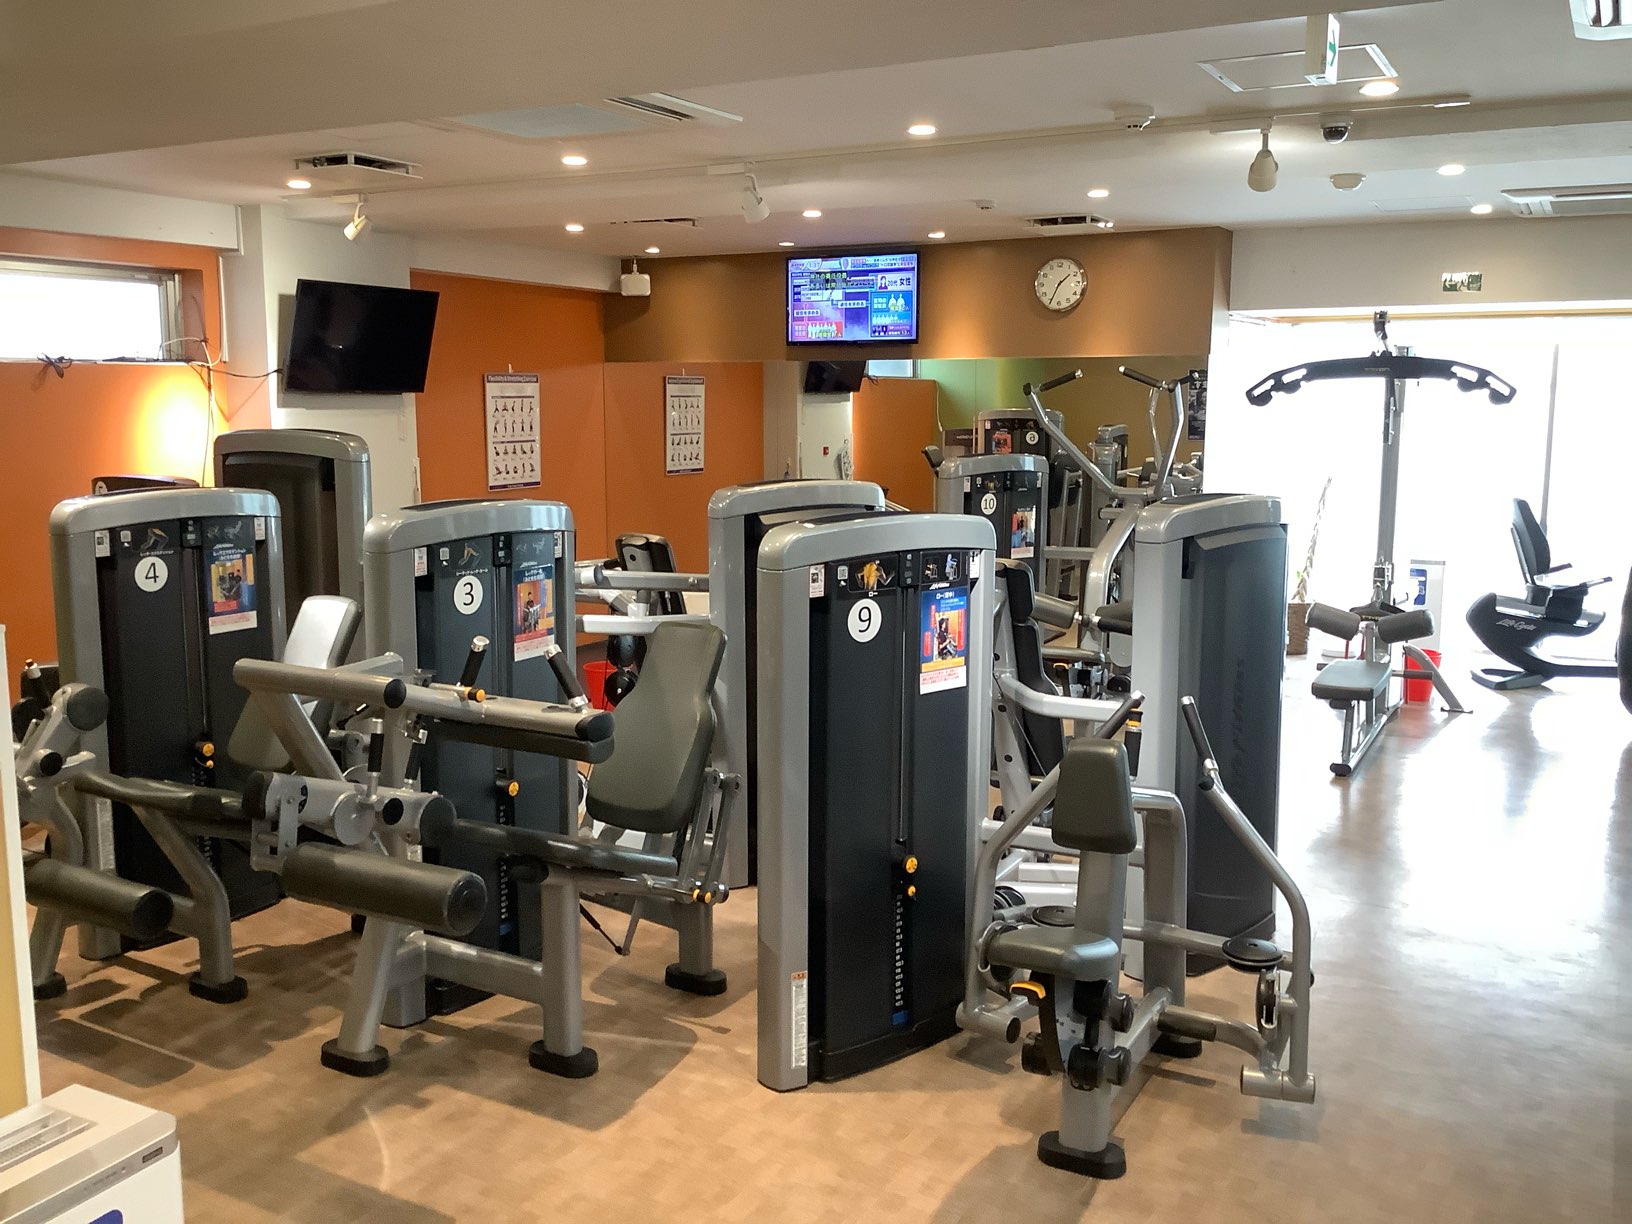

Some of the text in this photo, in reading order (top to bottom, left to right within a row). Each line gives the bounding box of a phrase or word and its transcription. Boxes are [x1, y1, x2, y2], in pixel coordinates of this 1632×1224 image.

[899, 279, 911, 288] 女性
[983, 498, 995, 510] 10
[144, 562, 160, 584] 4
[462, 581, 475, 607] 3
[858, 606, 872, 633] 9
